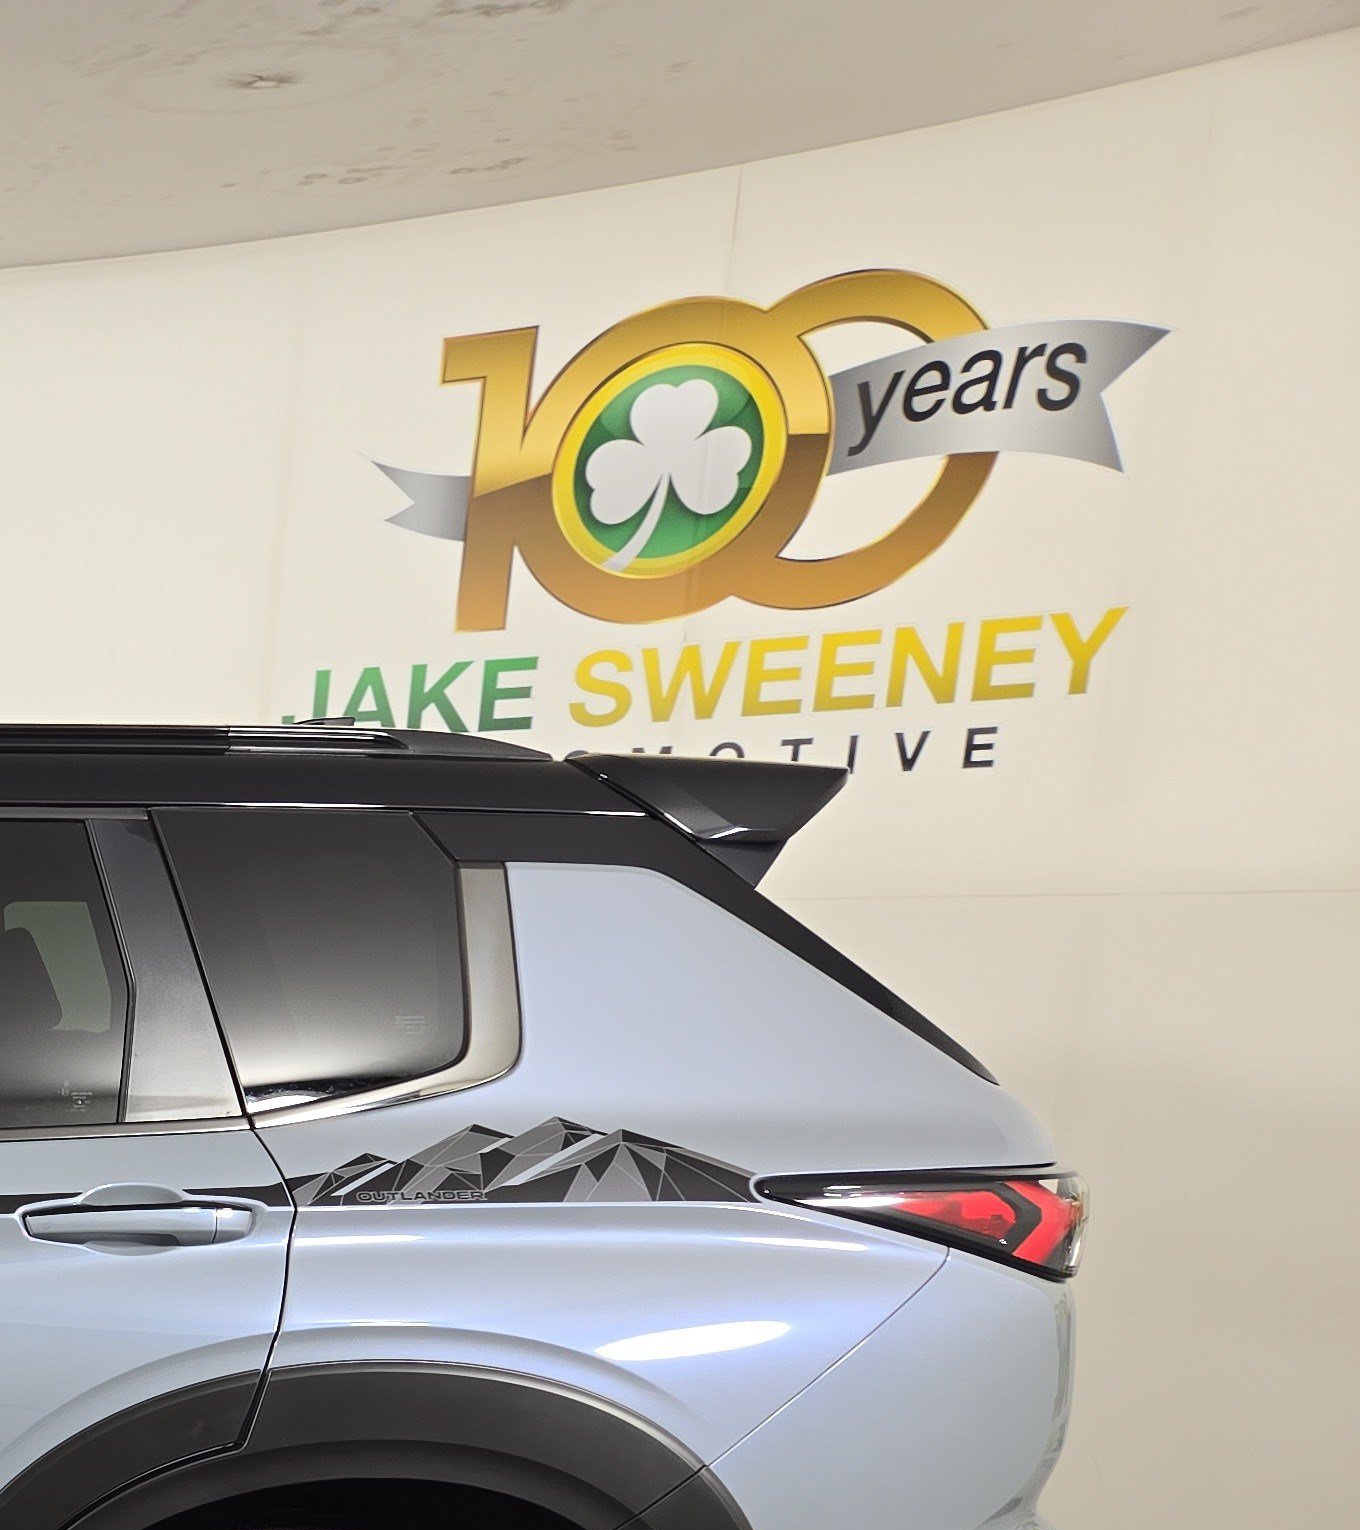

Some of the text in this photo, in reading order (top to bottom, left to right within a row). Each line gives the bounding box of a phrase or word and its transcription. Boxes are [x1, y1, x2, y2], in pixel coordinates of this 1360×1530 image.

[440, 269, 998, 631] 100
[847, 341, 1087, 457] years
[281, 606, 1128, 733] JAKE SWEENEY
[356, 1190, 487, 1203] OUTLANDER
